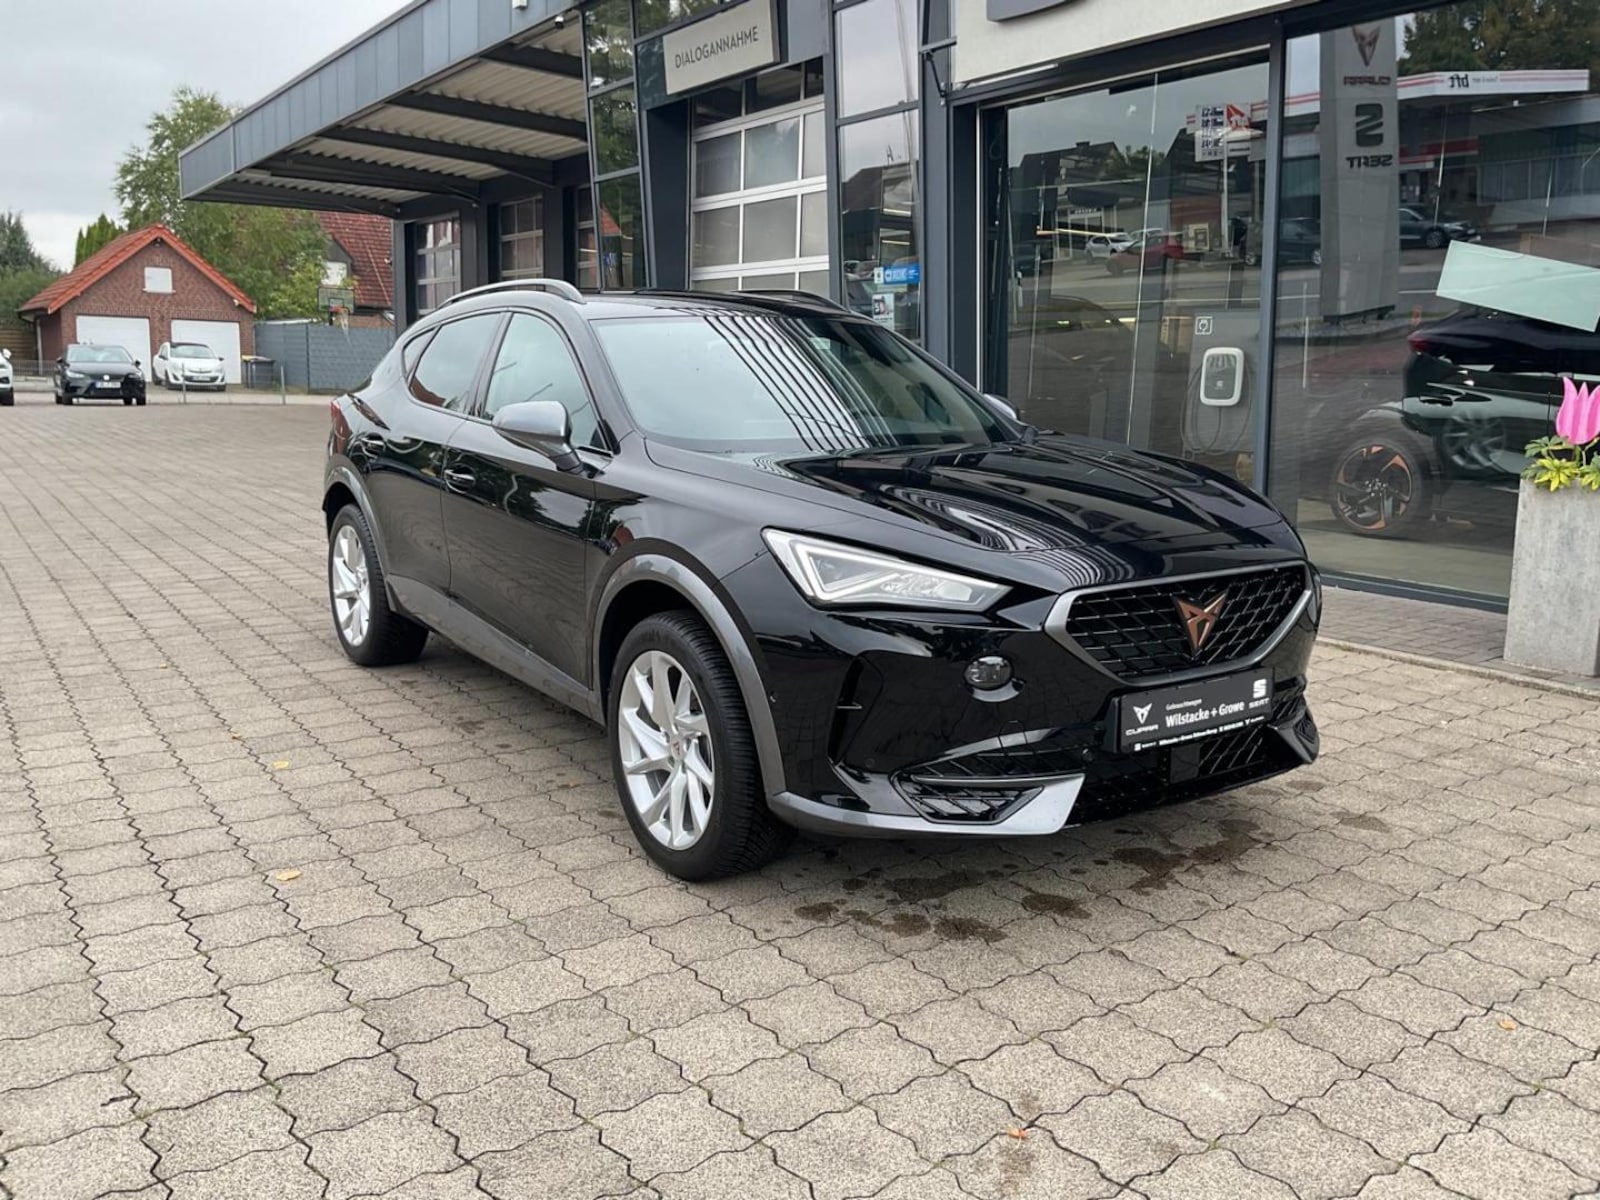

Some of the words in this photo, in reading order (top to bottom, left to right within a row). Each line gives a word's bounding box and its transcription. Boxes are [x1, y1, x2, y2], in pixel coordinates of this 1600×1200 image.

[675, 26, 759, 69] DIALOGANNAHME
[1248, 697, 1270, 709] SEAT
[1165, 707, 1210, 728] Wilstacke
[1218, 701, 1245, 716] Growe
[1125, 724, 1158, 736] CUPRA
